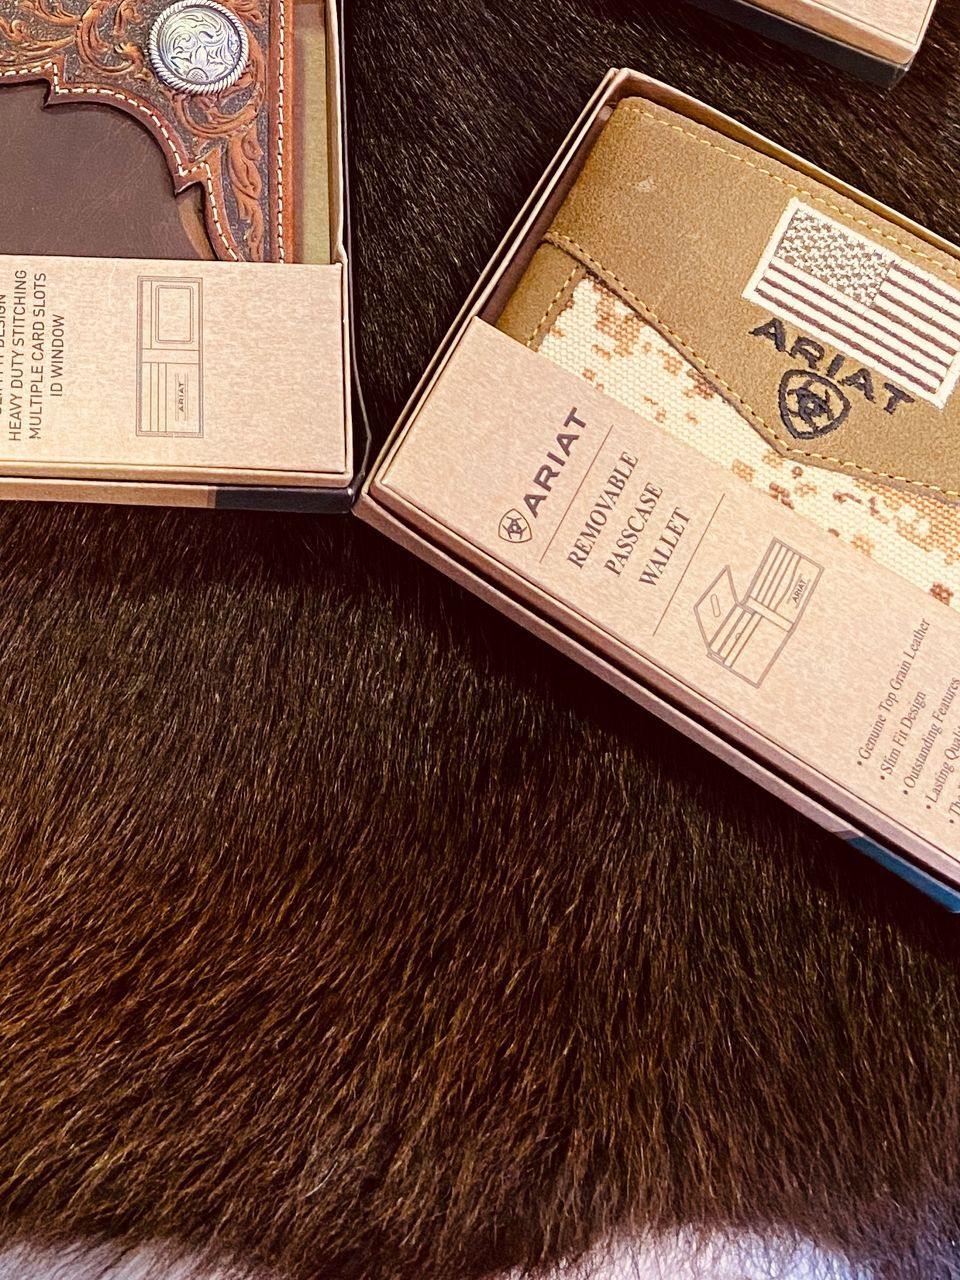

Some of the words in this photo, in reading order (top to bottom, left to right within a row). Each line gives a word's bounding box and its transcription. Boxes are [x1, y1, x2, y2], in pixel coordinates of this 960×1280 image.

[12, 270, 27, 346] STITCHING
[33, 273, 46, 317] SLOTS
[11, 350, 24, 388] DUTY
[31, 322, 45, 361] CARD
[51, 314, 65, 378] WINDOW
[748, 318, 915, 415] ARIAT
[9, 394, 22, 441] HEAVY
[29, 365, 43, 439] MULTIPLE
[50, 382, 63, 396] ID
[523, 407, 586, 518] ARIAT
[567, 451, 639, 569] REMOVABLE
[604, 482, 663, 577] PASSCASE
[638, 507, 690, 586] WALLET
[792, 580, 806, 603] ARIAT
[858, 714, 886, 761] Genuine
[879, 691, 898, 714] Top
[890, 659, 912, 691] Grain
[904, 618, 930, 659] Leather
[880, 747, 900, 775] Slim
[893, 728, 909, 746] Fit
[901, 691, 927, 730] Design
[903, 720, 942, 789] Outstanding
[932, 677, 960, 722] Features
[925, 761, 954, 803] Lasting
